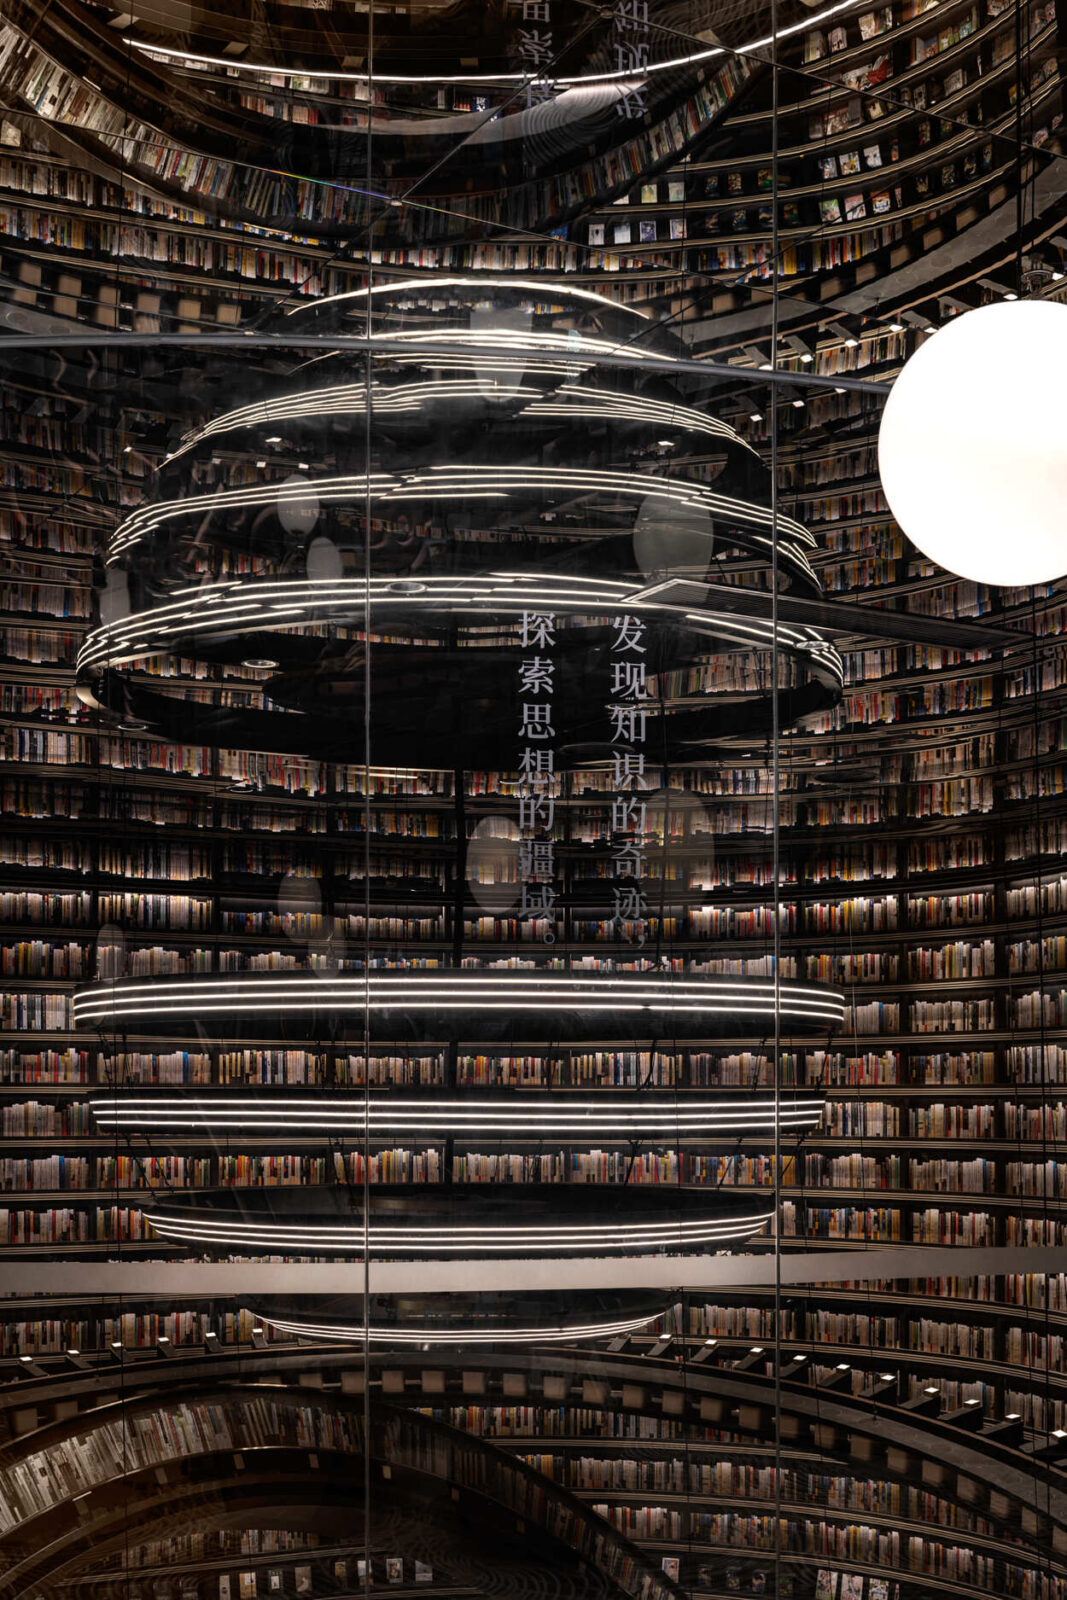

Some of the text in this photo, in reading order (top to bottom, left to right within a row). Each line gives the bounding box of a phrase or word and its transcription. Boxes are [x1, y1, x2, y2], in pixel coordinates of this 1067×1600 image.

[517, 610, 557, 945] 探索思想的疆域。
